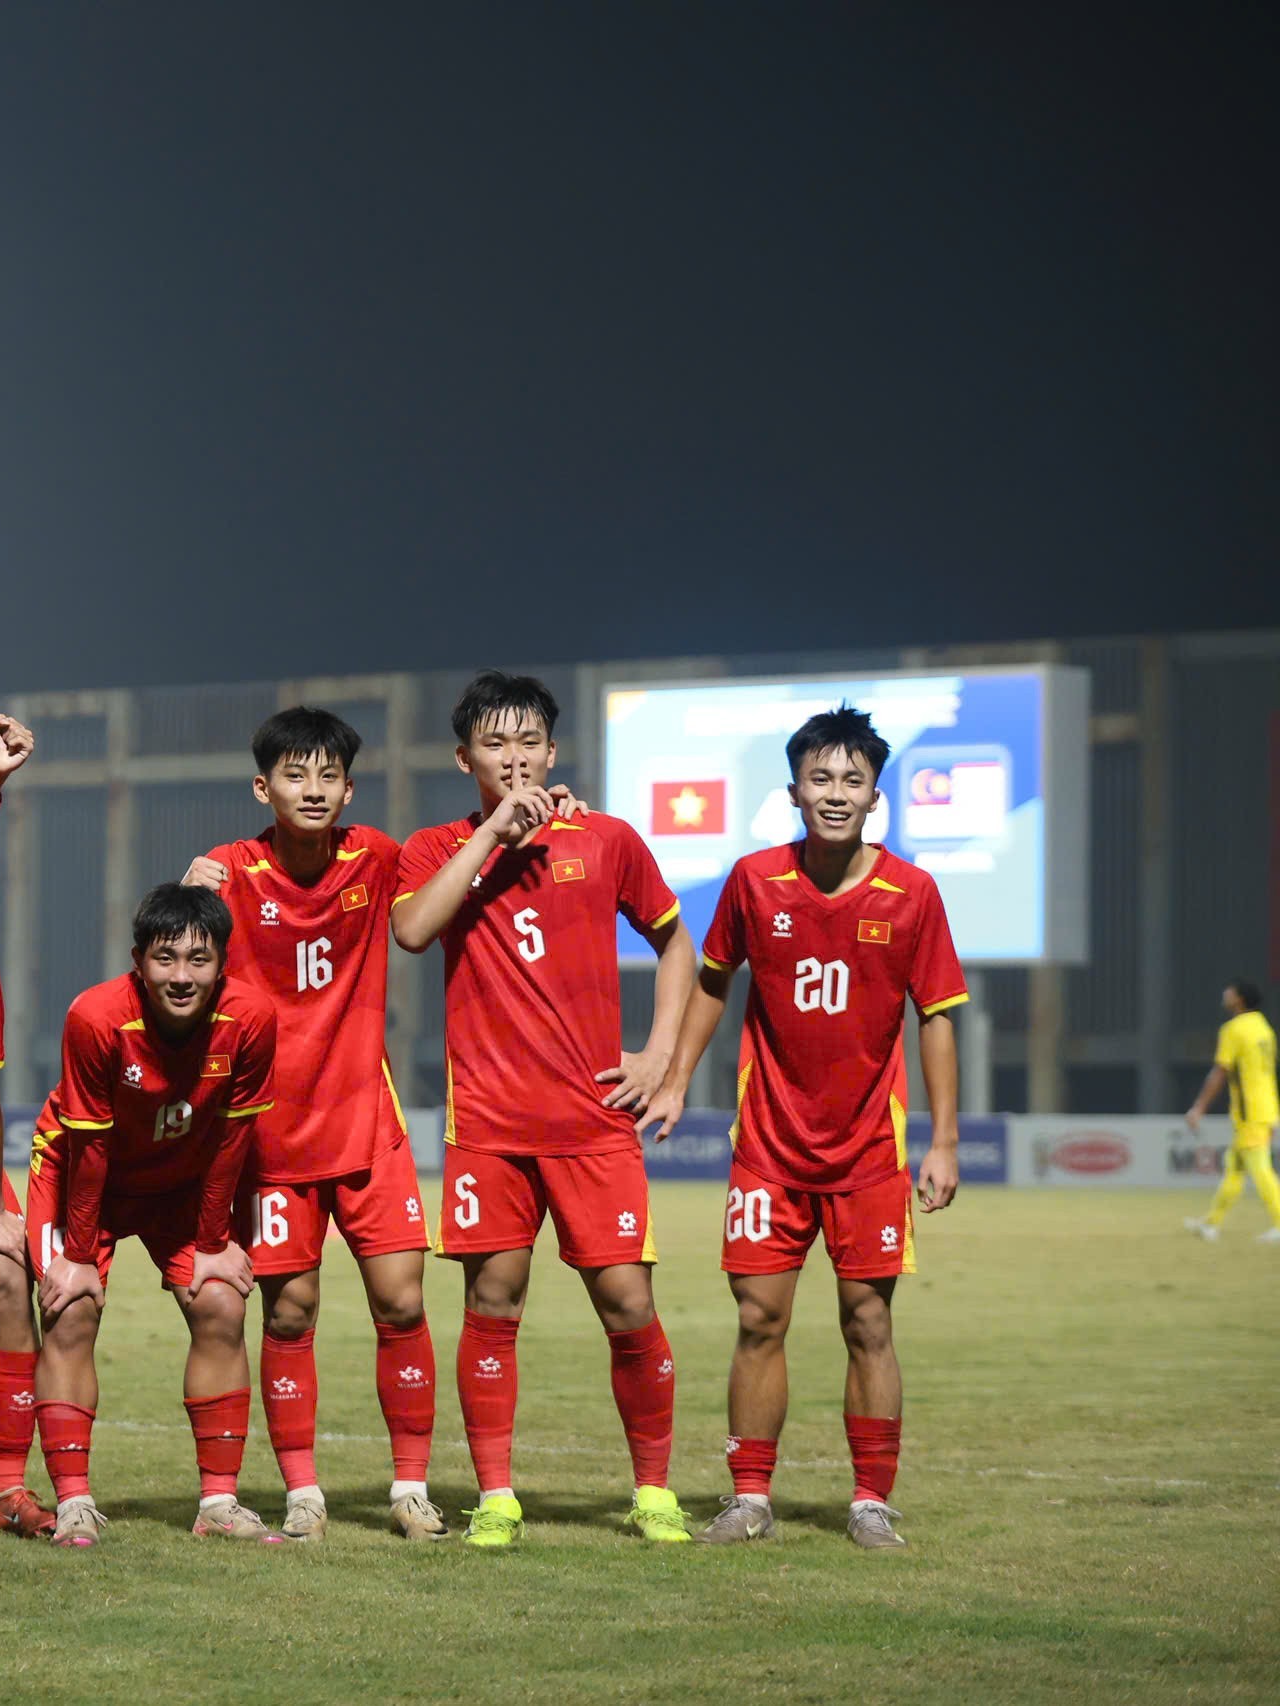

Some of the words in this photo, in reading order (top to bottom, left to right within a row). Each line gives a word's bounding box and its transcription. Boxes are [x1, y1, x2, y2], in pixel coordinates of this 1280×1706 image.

[513, 906, 546, 963] 5
[296, 936, 333, 993] 16
[793, 956, 850, 1016] 20
[153, 1099, 193, 1142] 19
[250, 1191, 288, 1247] 16
[454, 1172, 480, 1230] 5
[726, 1186, 772, 1243] 20
